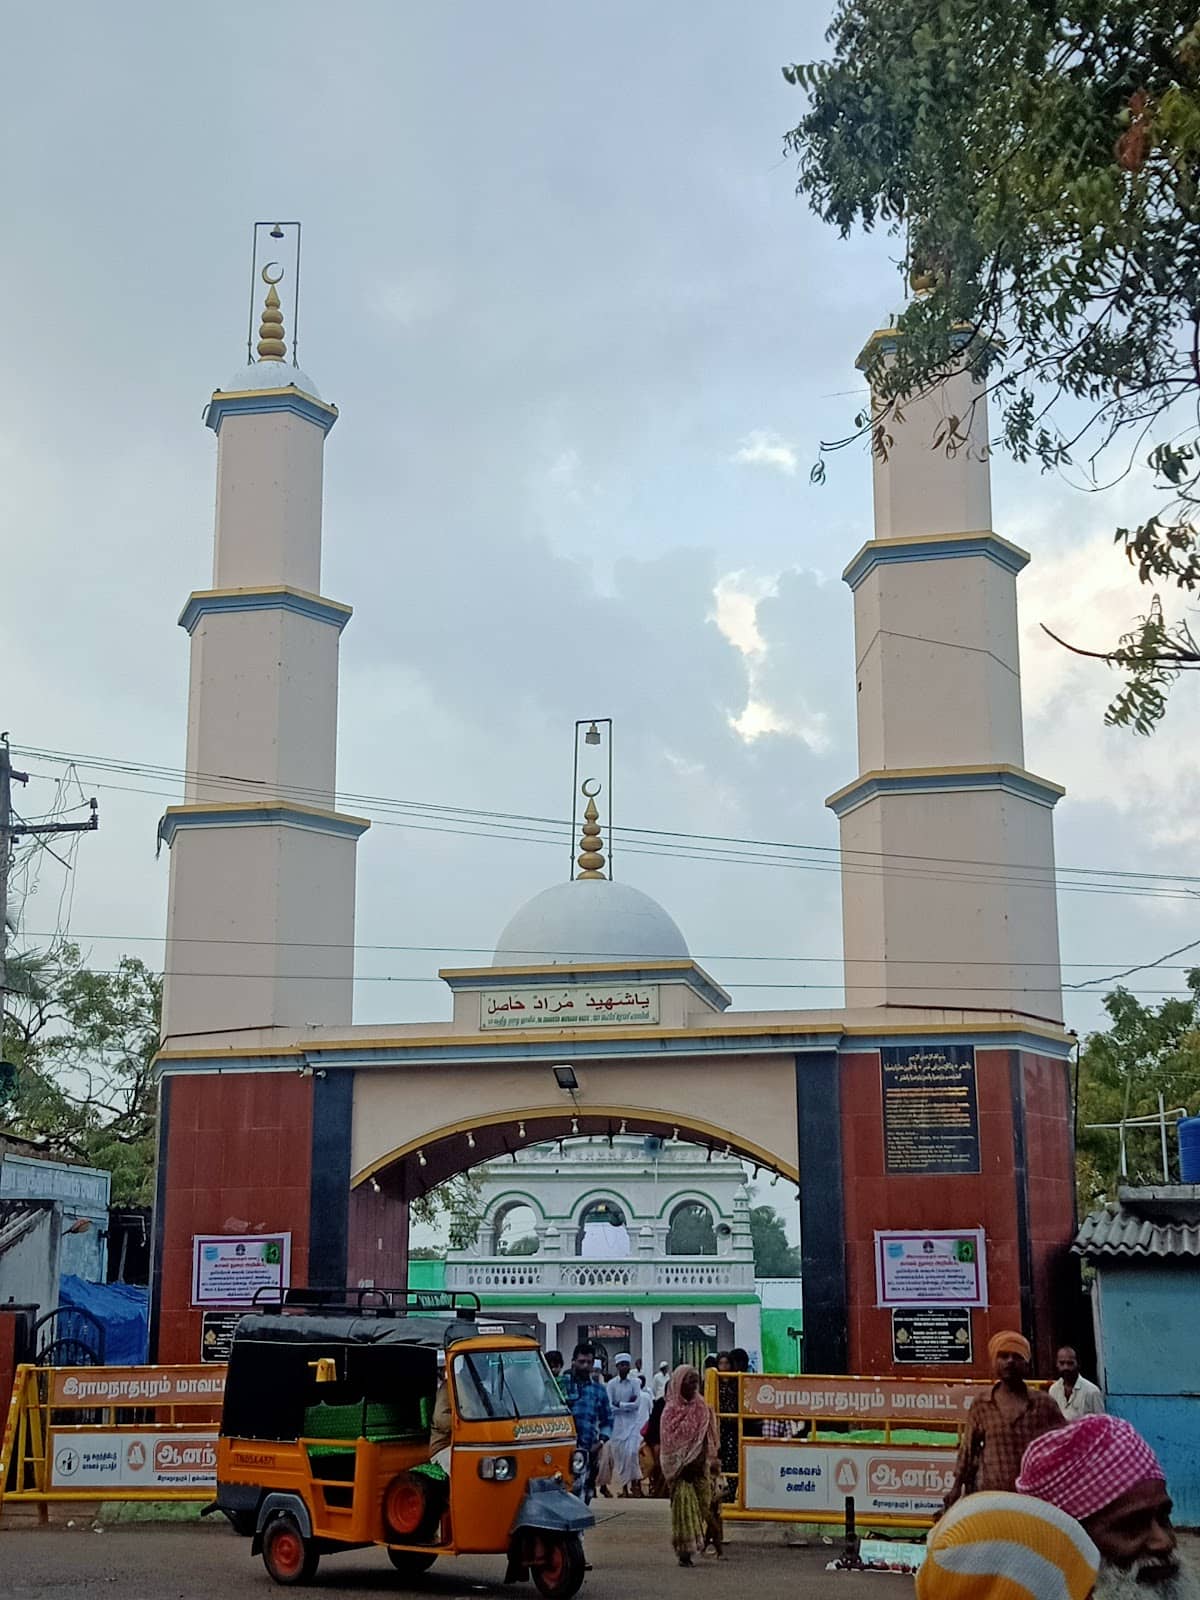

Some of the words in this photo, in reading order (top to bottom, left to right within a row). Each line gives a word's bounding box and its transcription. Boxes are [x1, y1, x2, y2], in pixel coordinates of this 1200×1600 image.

[63, 1375, 171, 1400] இராமநாதபுரம்
[757, 1384, 885, 1411] இராமநாதபுரம்
[891, 1393, 957, 1409] மாவட்ட
[157, 1442, 217, 1468] ஆனந்
